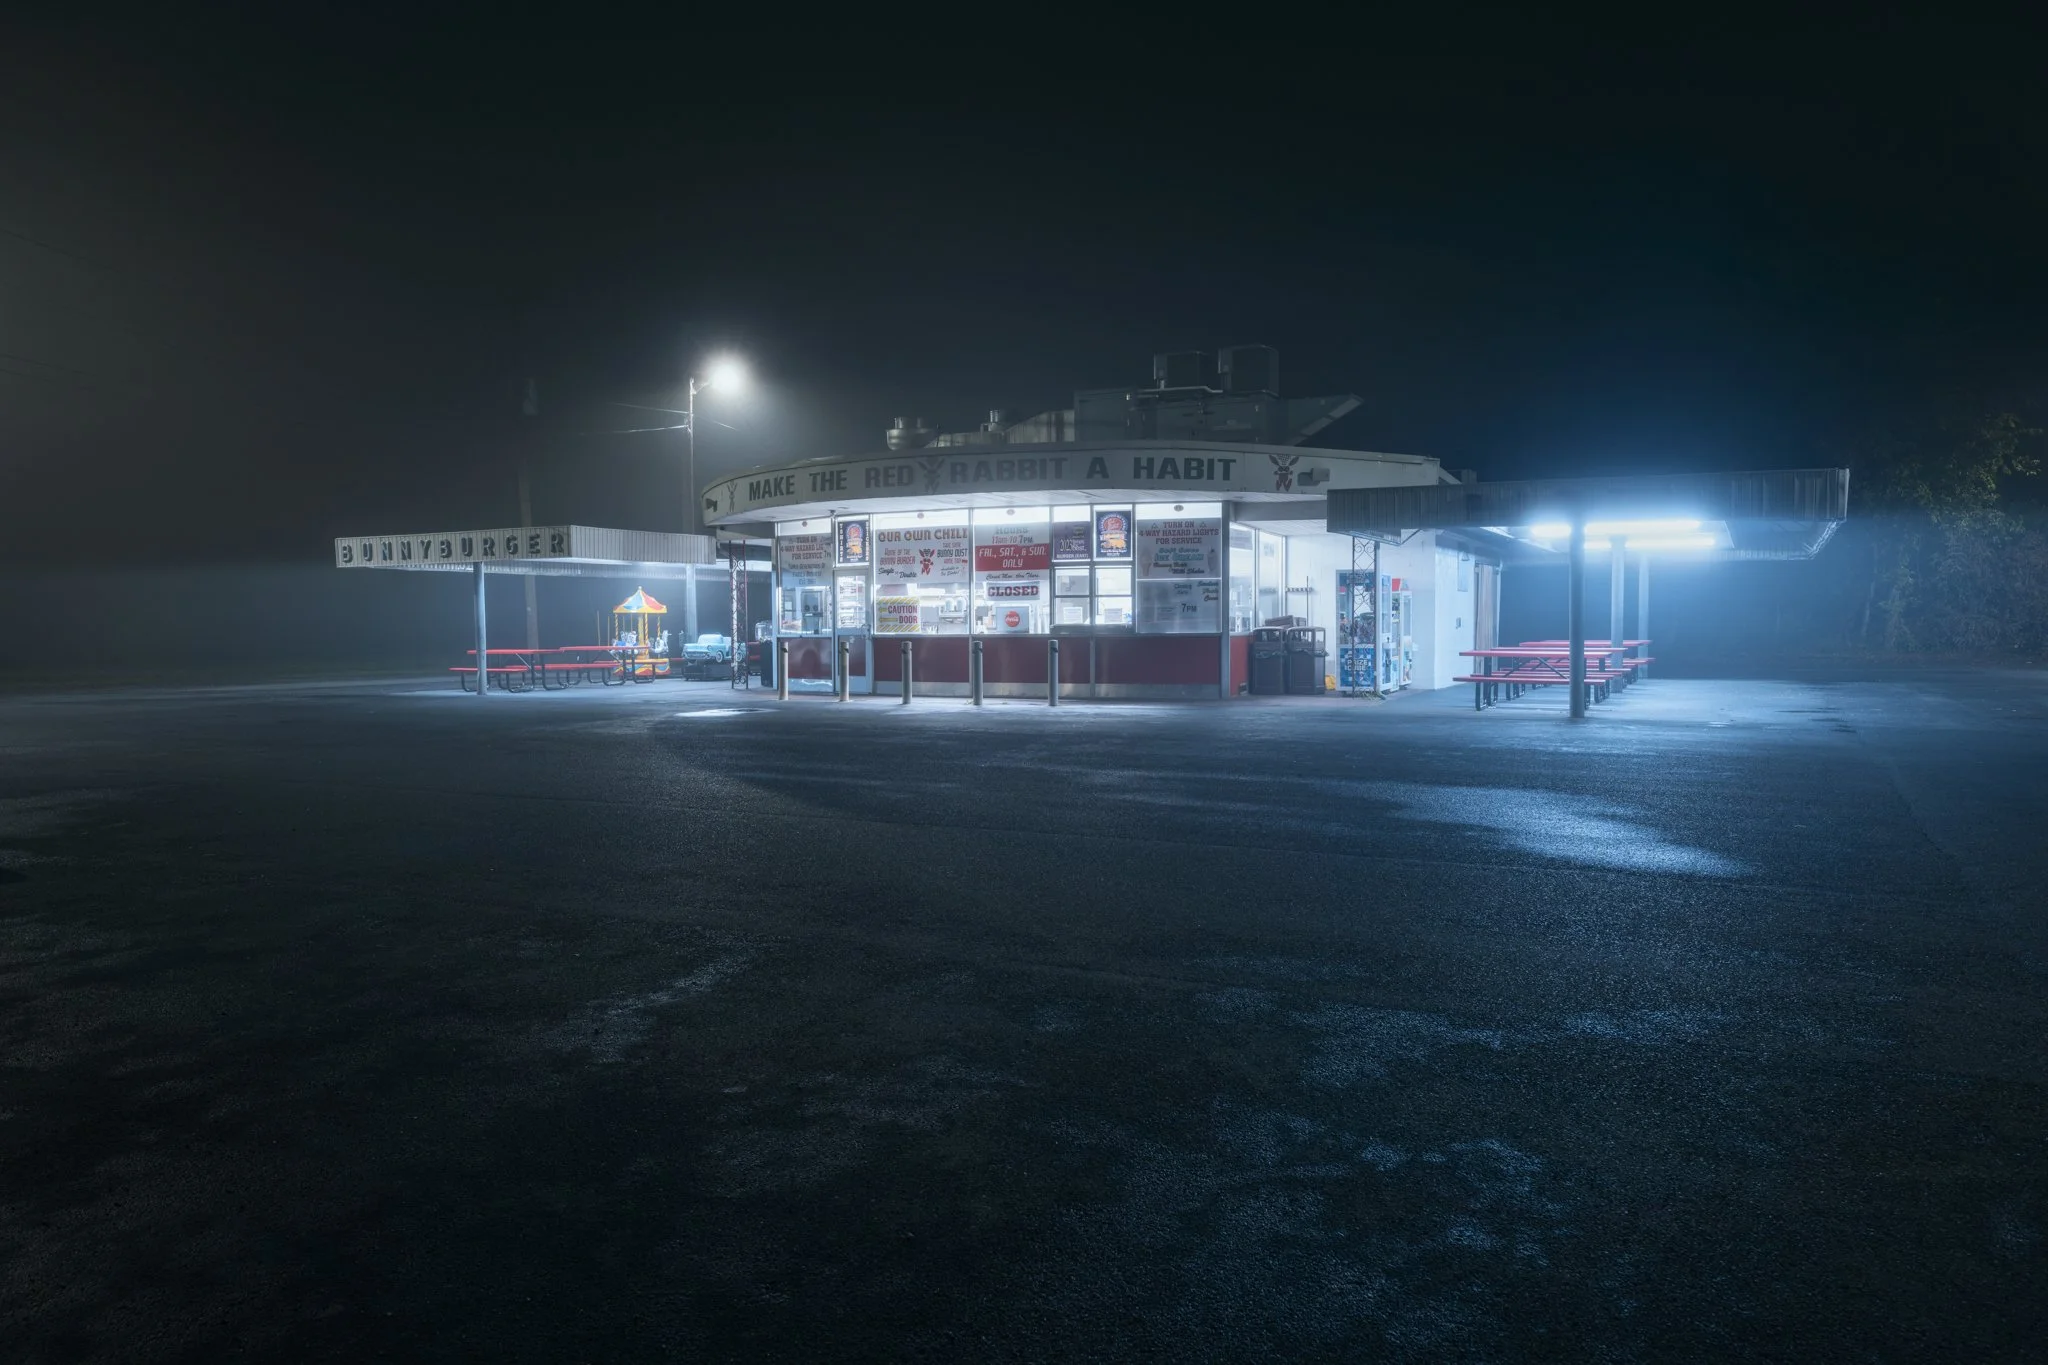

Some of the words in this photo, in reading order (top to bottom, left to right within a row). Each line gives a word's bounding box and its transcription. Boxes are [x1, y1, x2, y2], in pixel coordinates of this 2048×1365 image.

[749, 475, 795, 501] MAKE
[809, 470, 847, 492] THE
[865, 465, 913, 488] RED
[950, 457, 1068, 483] RABBIT
[1086, 457, 1109, 479] A
[1133, 457, 1236, 481] HABIT
[1163, 521, 1183, 529] TURN
[878, 531, 901, 542] OUR
[904, 530, 932, 541] OWN
[934, 528, 968, 540] CHILI
[1162, 529, 1191, 537] HAZARD
[1193, 528, 1220, 536] LIGHTS
[342, 532, 565, 563] BUNNYBURGER
[955, 548, 968, 557] DUST
[1003, 559, 1023, 568] ONLY
[988, 585, 1039, 597] CLOSED
[887, 605, 918, 614] CAUTION
[1181, 603, 1197, 612] 7PM
